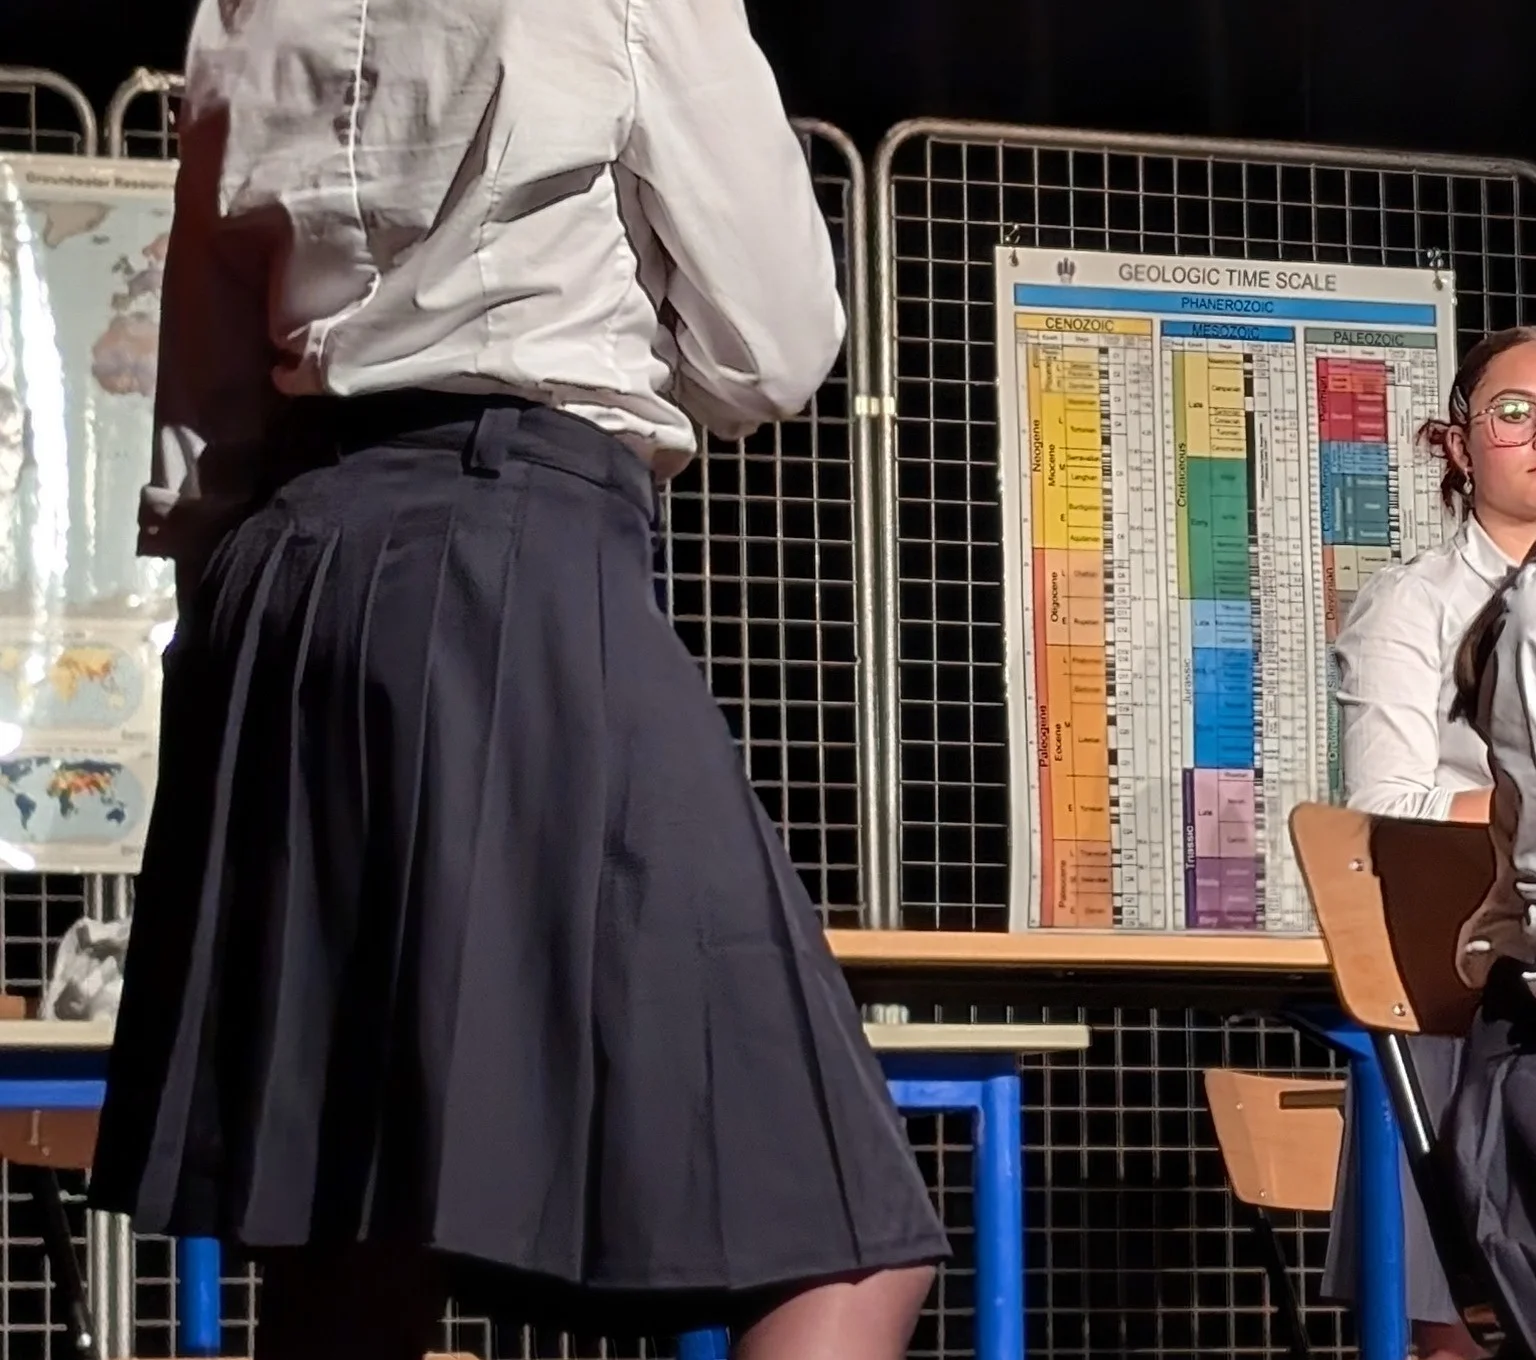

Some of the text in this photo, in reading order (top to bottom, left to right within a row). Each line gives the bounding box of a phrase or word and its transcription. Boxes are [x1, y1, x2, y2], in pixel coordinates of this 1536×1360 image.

[1118, 262, 1337, 291] GEOLOGIC TIME SCALE
[1045, 316, 1115, 332] CENOZOIC
[1181, 296, 1275, 314] PHANEROZOIC
[1192, 323, 1261, 340] MESOZOIC
[1333, 330, 1406, 347] PALEOZOIC
[1032, 419, 1044, 472] Neogene
[1048, 444, 1056, 487] Miocene
[1176, 442, 1187, 508] Cretaceous
[1050, 571, 1060, 622] Oligocene
[1325, 567, 1336, 621] Devonian
[1183, 657, 1193, 705] Jurassic
[1039, 704, 1050, 768] Paleogene
[1054, 723, 1063, 762] Eocene
[1185, 825, 1195, 869] Triassic
